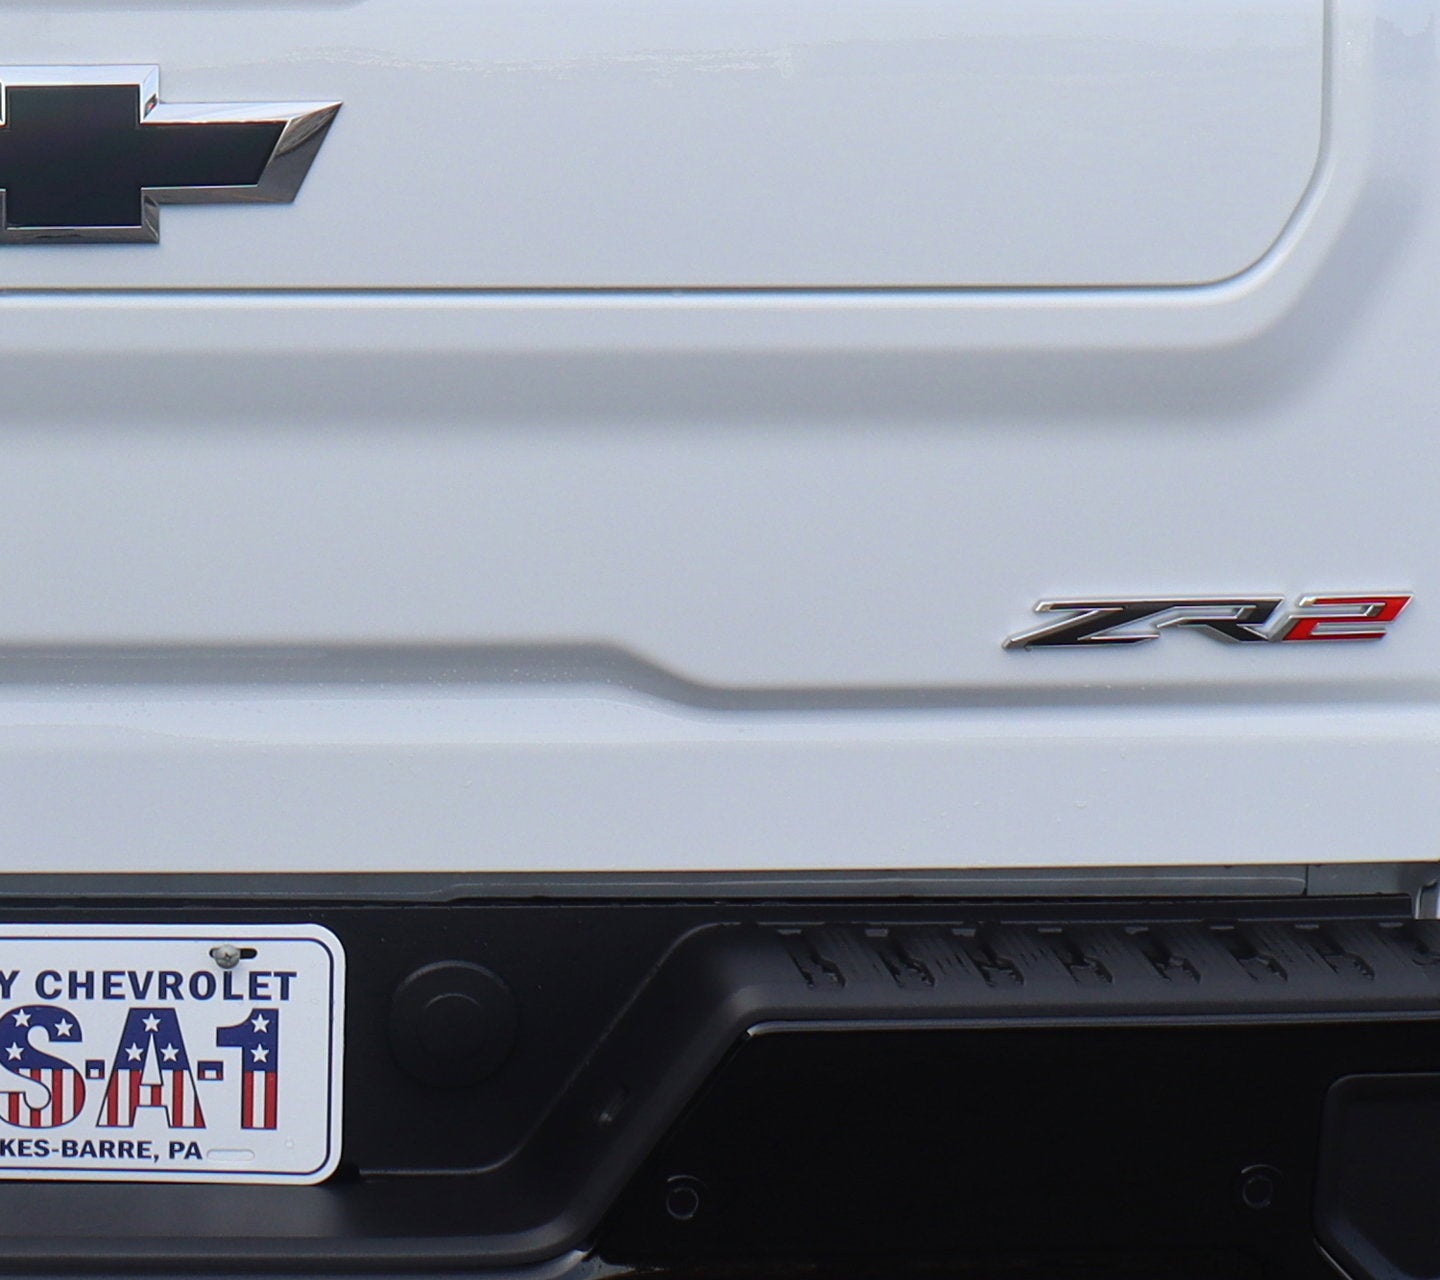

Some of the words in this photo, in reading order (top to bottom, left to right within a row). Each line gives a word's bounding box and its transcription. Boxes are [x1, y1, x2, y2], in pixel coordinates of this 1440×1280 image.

[1001, 593, 1415, 651] ZR2
[34, 970, 298, 1002] CHEVROLET
[168, 1141, 203, 1161] PA
